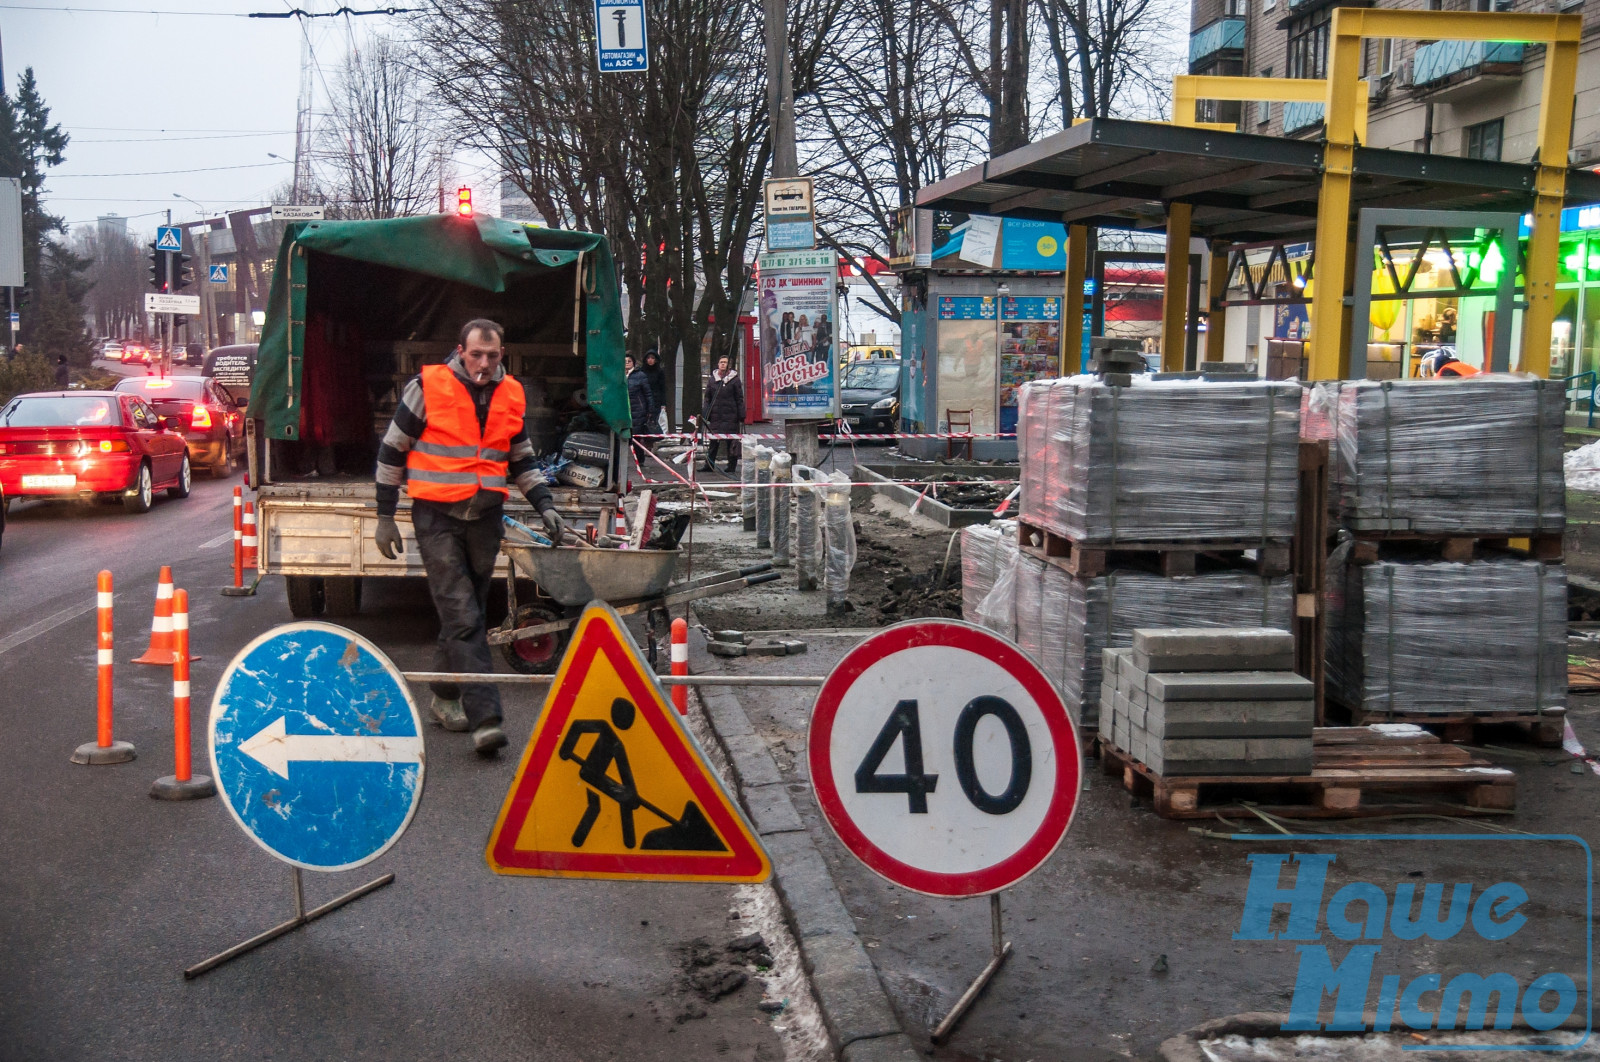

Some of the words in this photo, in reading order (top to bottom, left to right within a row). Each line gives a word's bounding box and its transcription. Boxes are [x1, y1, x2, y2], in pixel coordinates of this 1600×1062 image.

[778, 278, 788, 288] ДК
[788, 277, 827, 286] "ШИННИК"
[774, 362, 828, 391] песня
[854, 694, 1033, 815] 40
